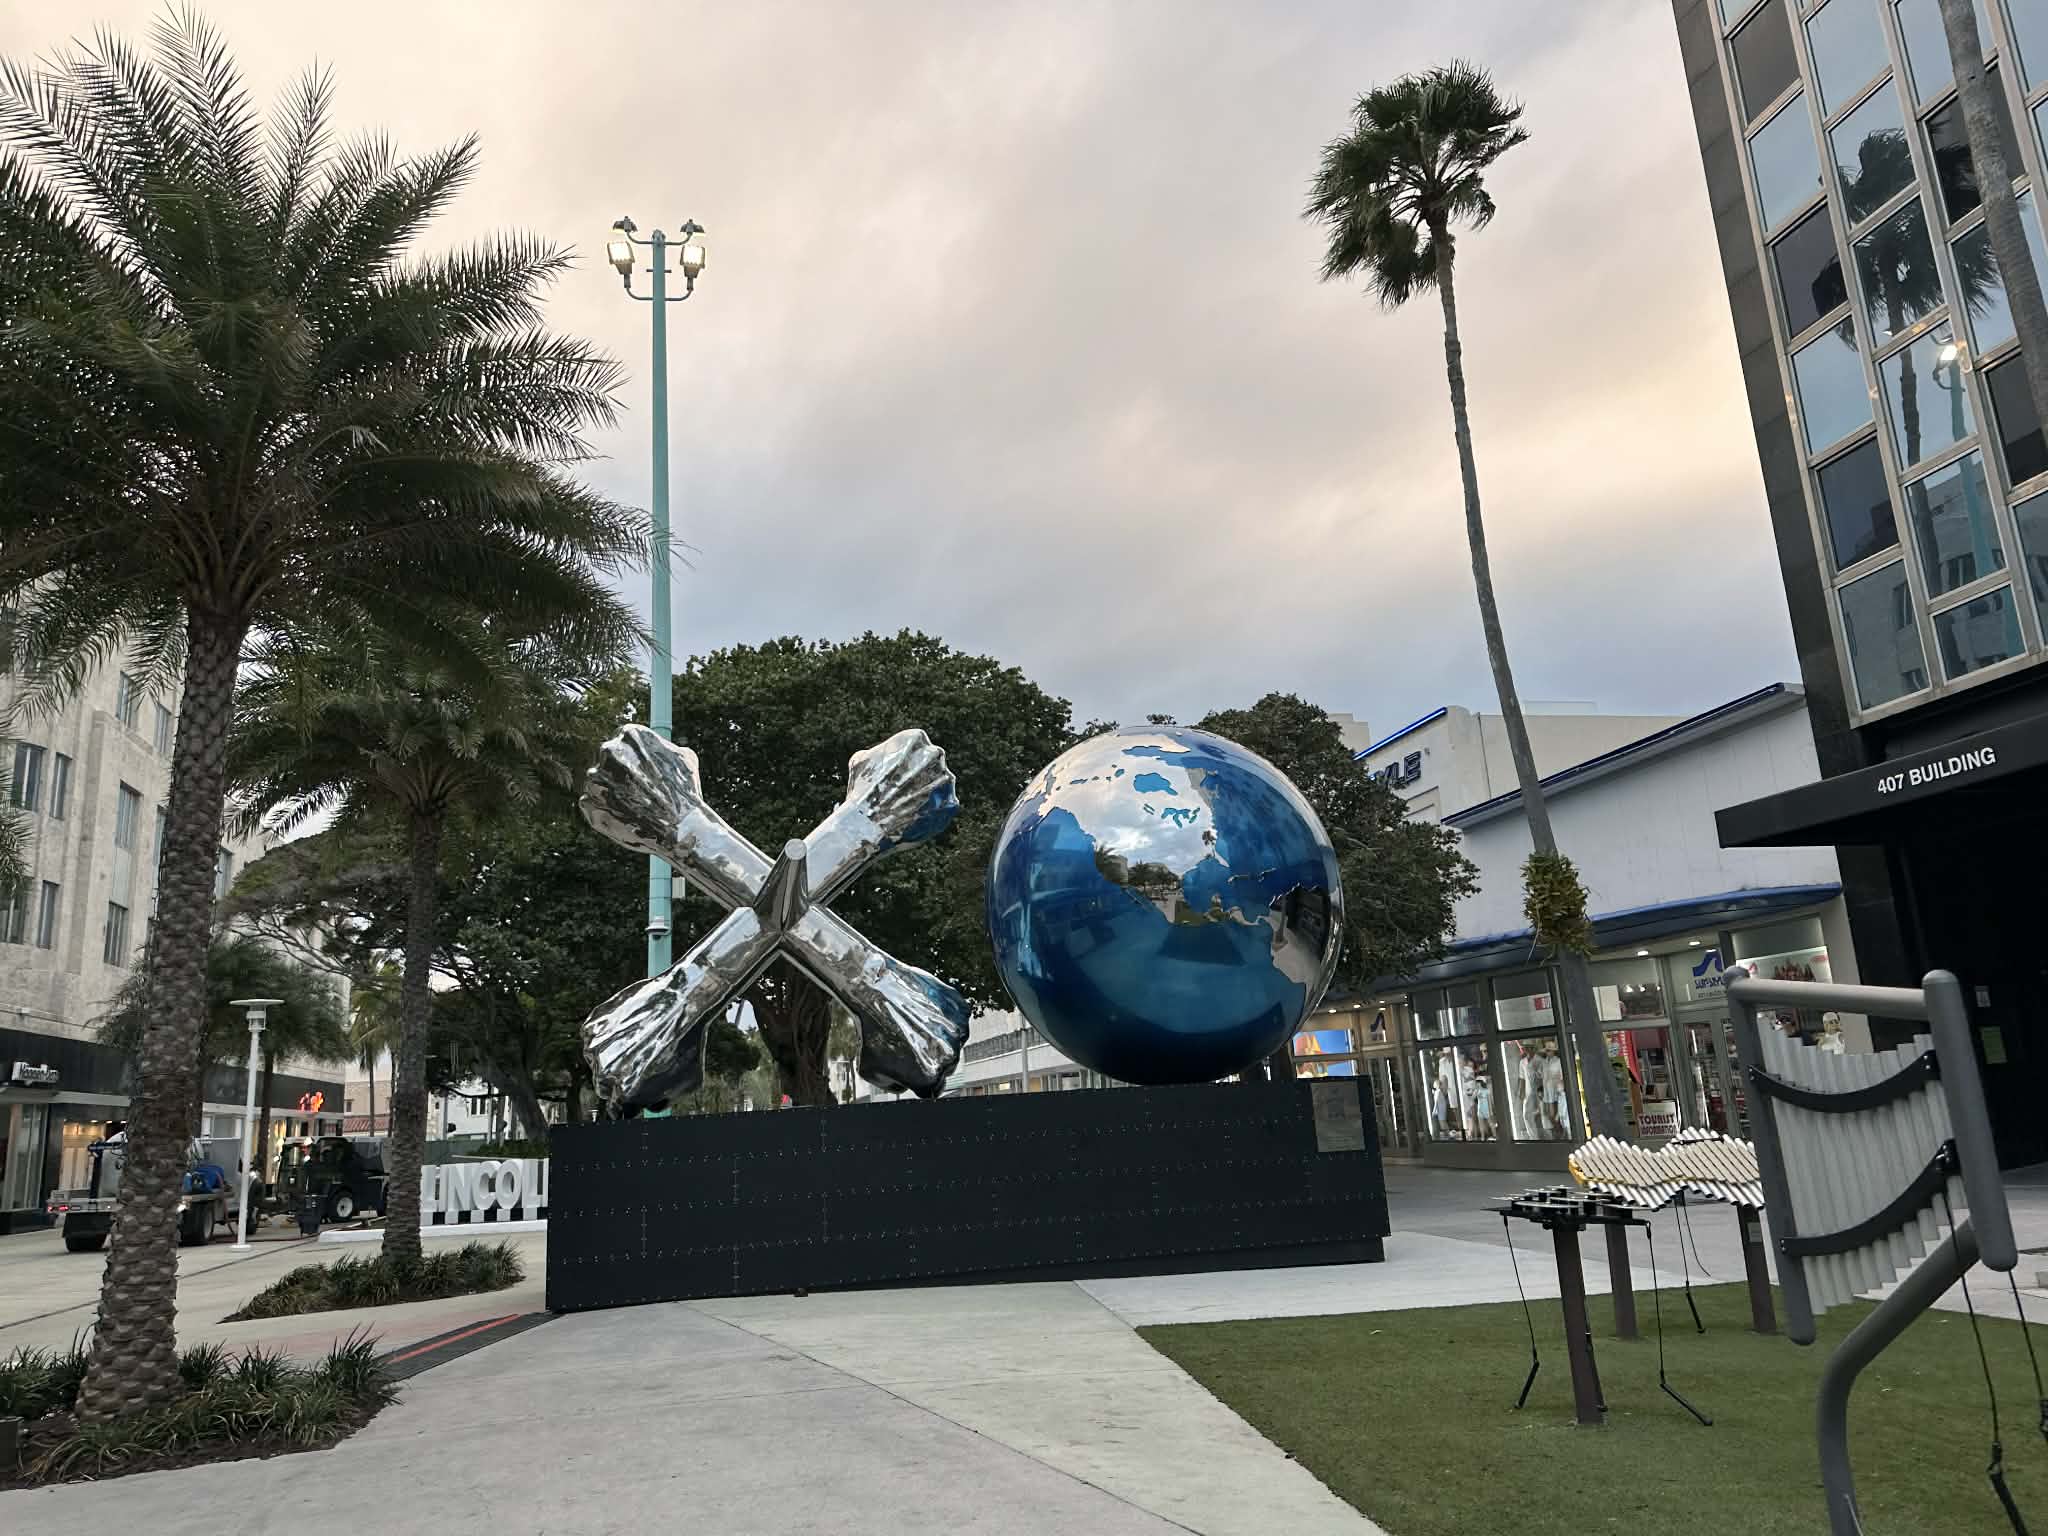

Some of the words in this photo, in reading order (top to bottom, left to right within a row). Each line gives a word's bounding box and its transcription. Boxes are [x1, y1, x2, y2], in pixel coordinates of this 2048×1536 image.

[1877, 773, 1904, 794] 407
[1908, 747, 1997, 786] BUILDING
[1638, 1113, 1675, 1125] TOURIST
